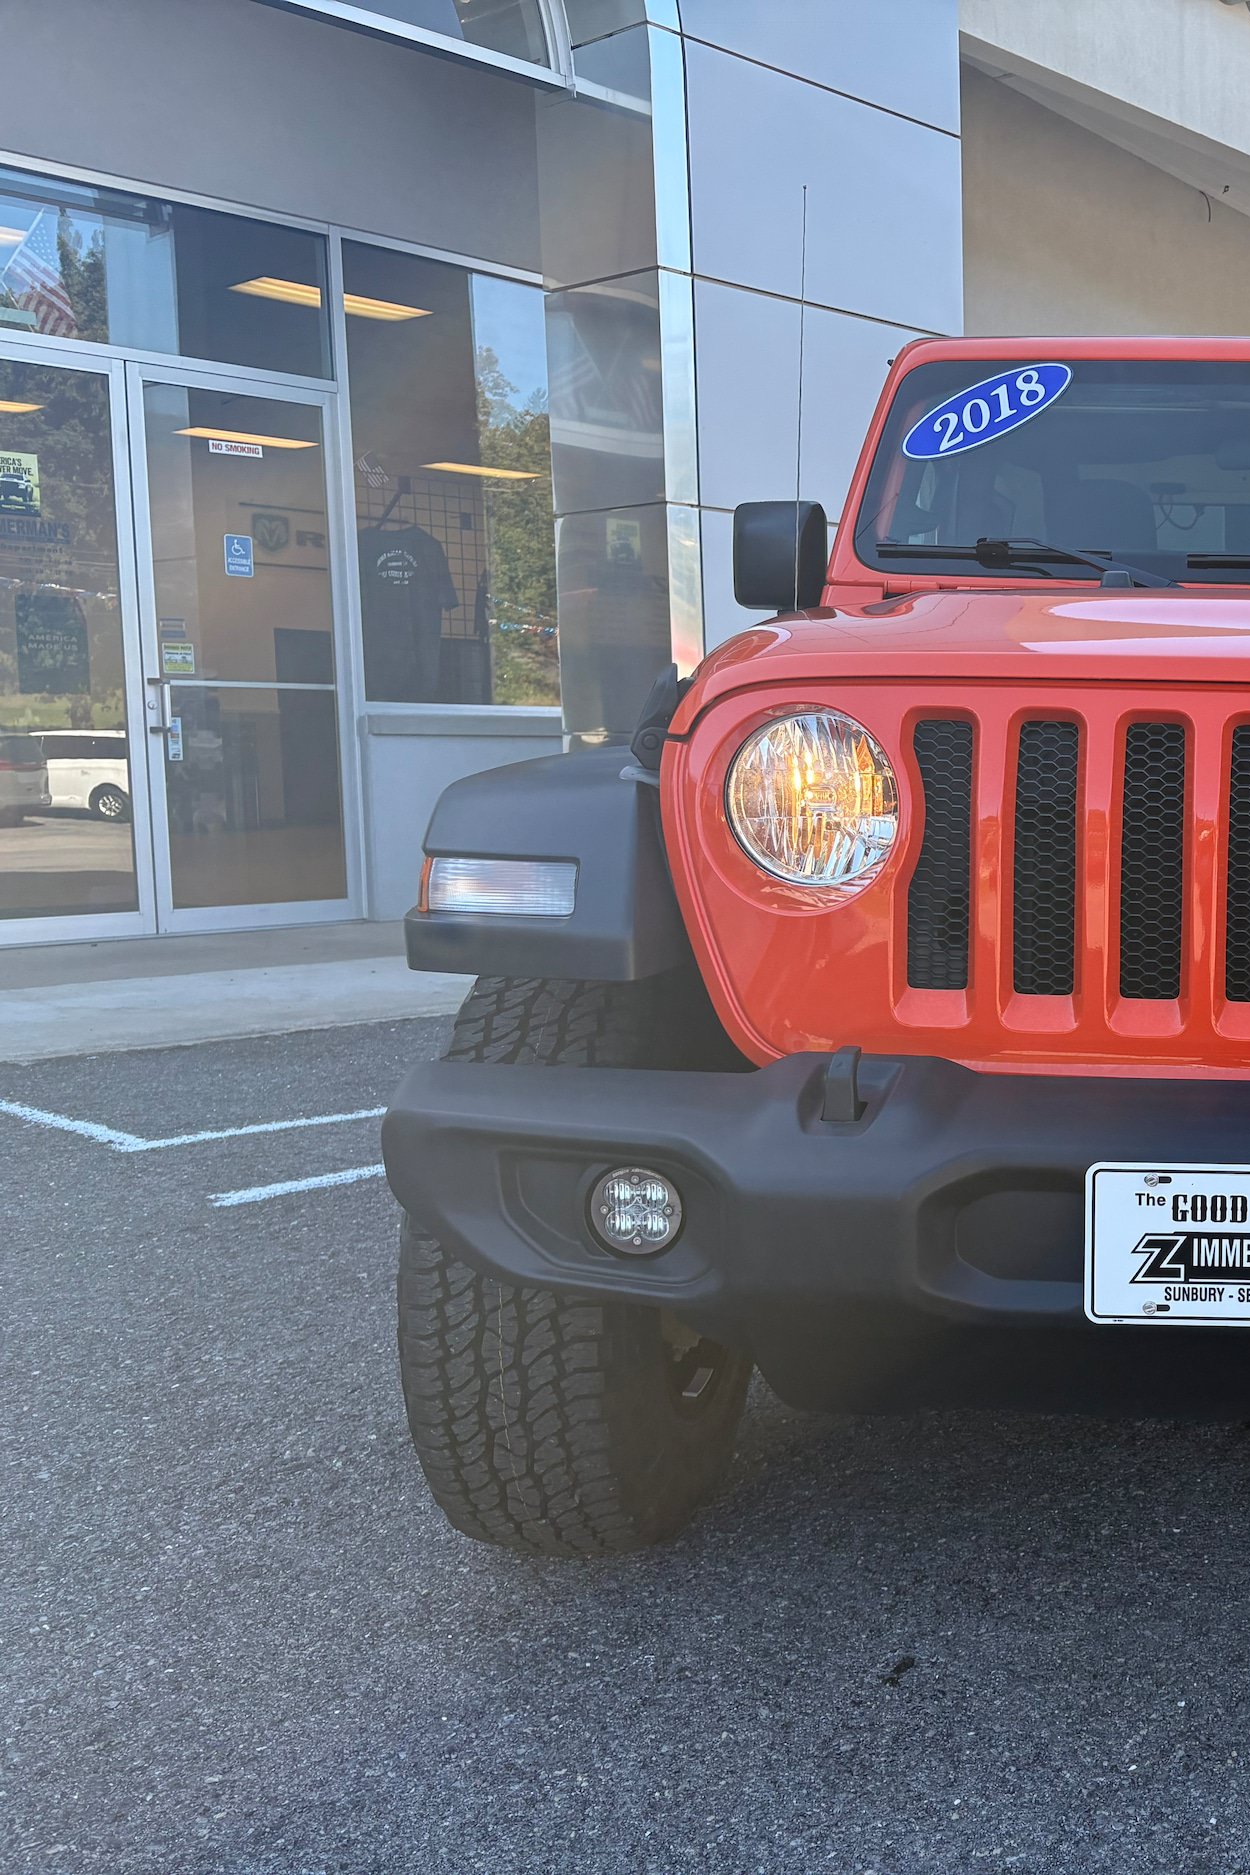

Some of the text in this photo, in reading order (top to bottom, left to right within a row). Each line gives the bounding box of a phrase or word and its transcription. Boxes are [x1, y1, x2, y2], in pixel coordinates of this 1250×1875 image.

[933, 370, 1046, 452] 2018
[211, 442, 260, 455] NO SMOKING
[0, 456, 22, 466] RICA'S
[28, 634, 77, 643] AMERICA
[28, 642, 78, 652] MADE US
[1135, 1193, 1166, 1207] The
[1171, 1193, 1248, 1224] GOOD
[1164, 1287, 1225, 1302] SUNBURY
